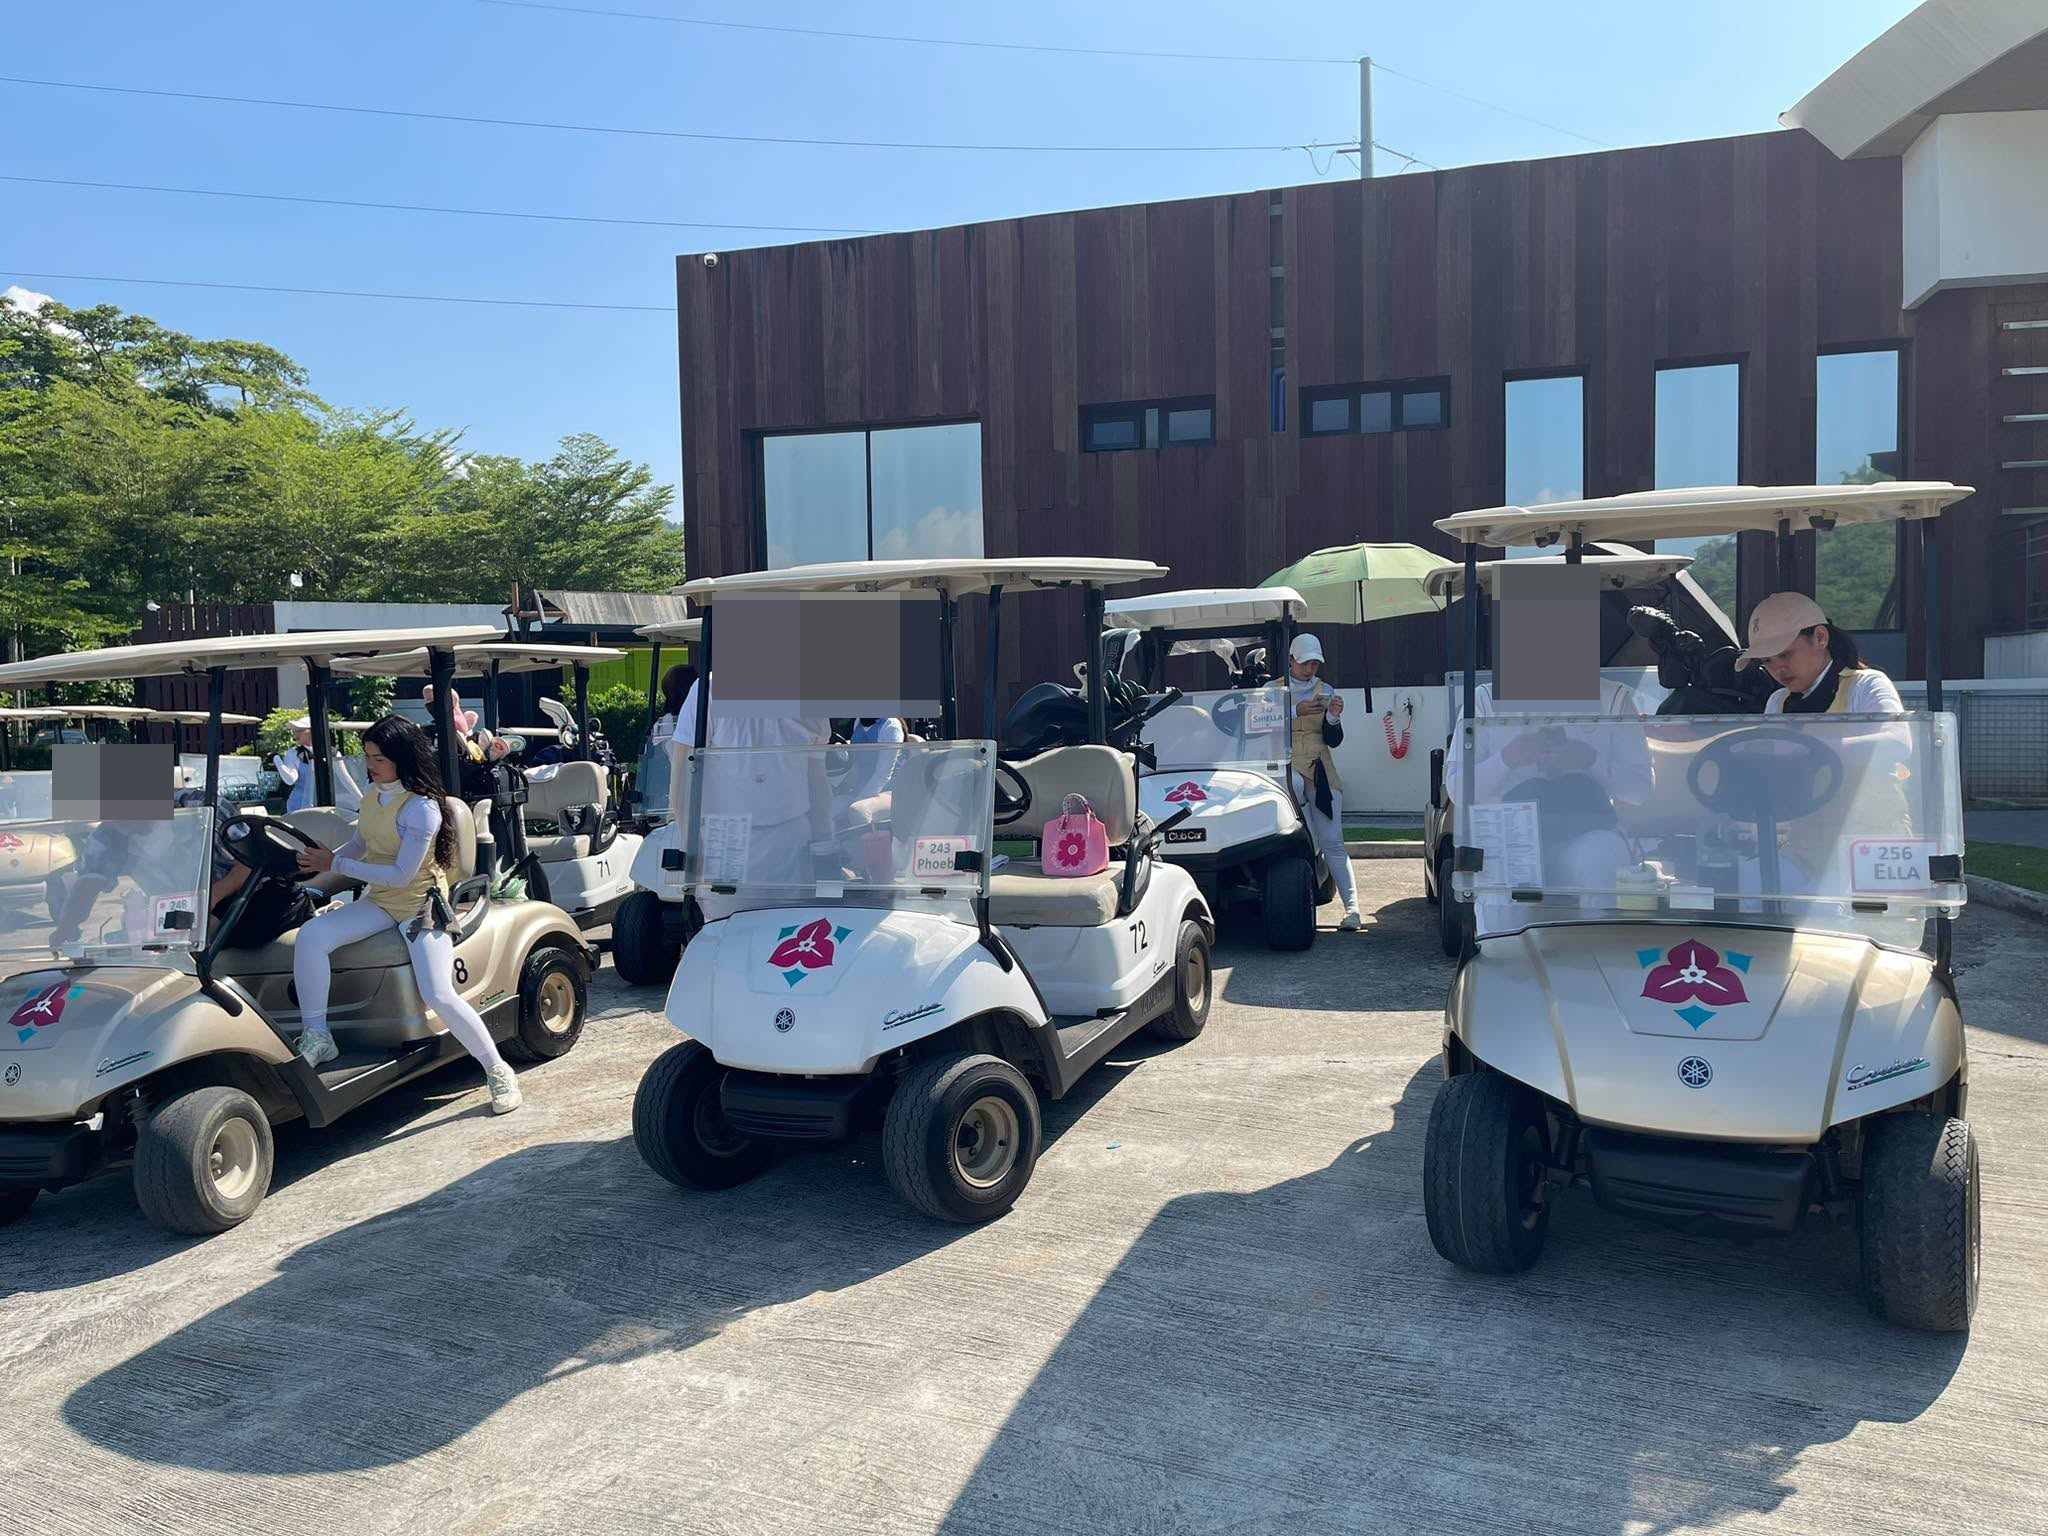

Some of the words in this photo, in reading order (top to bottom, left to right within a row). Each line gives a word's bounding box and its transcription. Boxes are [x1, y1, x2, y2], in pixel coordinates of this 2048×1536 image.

[929, 843, 951, 854] 243
[1878, 846, 1913, 860] 256
[597, 860, 610, 878] 71
[917, 856, 954, 870] Phoeb
[1129, 920, 1148, 954] 72
